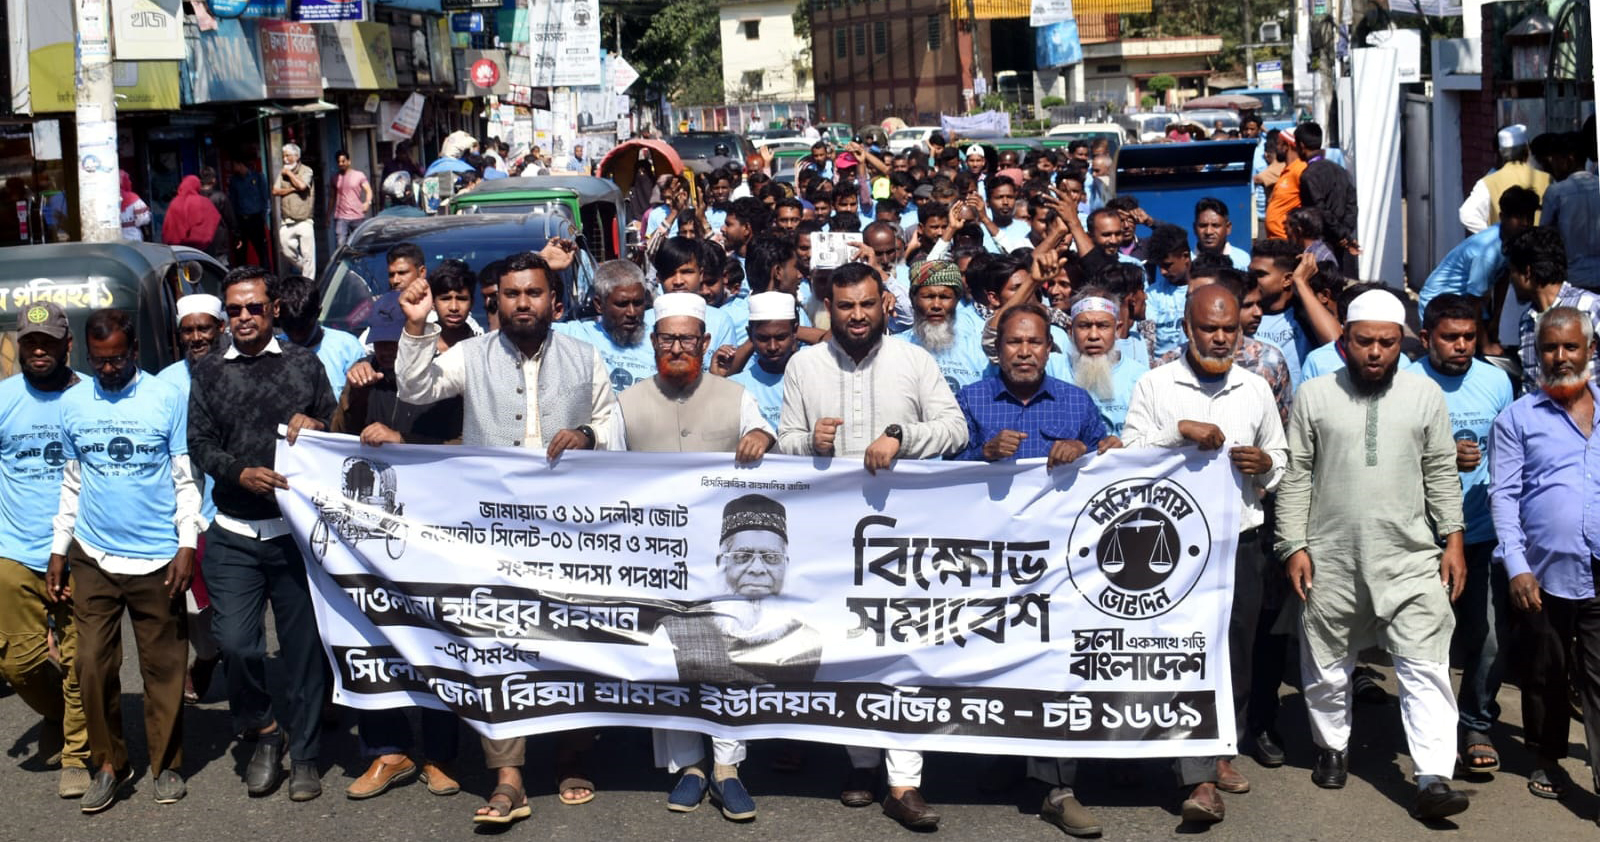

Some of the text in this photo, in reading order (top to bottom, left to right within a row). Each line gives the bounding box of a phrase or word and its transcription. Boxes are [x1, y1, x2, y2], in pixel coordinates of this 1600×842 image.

[15, 447, 42, 459] ভোট
[81, 443, 105, 454] ভোট
[479, 501, 689, 528] জামায়াত ও ১১ দলীয় জোট
[491, 522, 573, 549] সিলেট-০১
[578, 531, 621, 552] (নগর
[626, 536, 641, 551] ও
[645, 536, 689, 559] সদর)
[853, 515, 1050, 591] বিক্ষোভ
[560, 562, 612, 585] সদস্য
[618, 560, 689, 591] পদপ্রার্থী
[442, 588, 540, 634] হাবিবুর
[549, 602, 640, 632] রহমান
[846, 593, 1051, 648] সমাবেশ
[472, 643, 540, 666] সমর্থনে
[1071, 628, 1206, 652] চলো একসাথে গড়ি
[1069, 652, 1207, 681] বাংলাদেশ
[501, 674, 584, 711] রিক্সা
[700, 683, 846, 718] ইউনিয়ন,
[856, 686, 951, 722] রেজিঃ
[961, 698, 1005, 725] নং
[1042, 695, 1092, 731] চট্ট
[1101, 702, 1202, 729] ১৬৬৯
